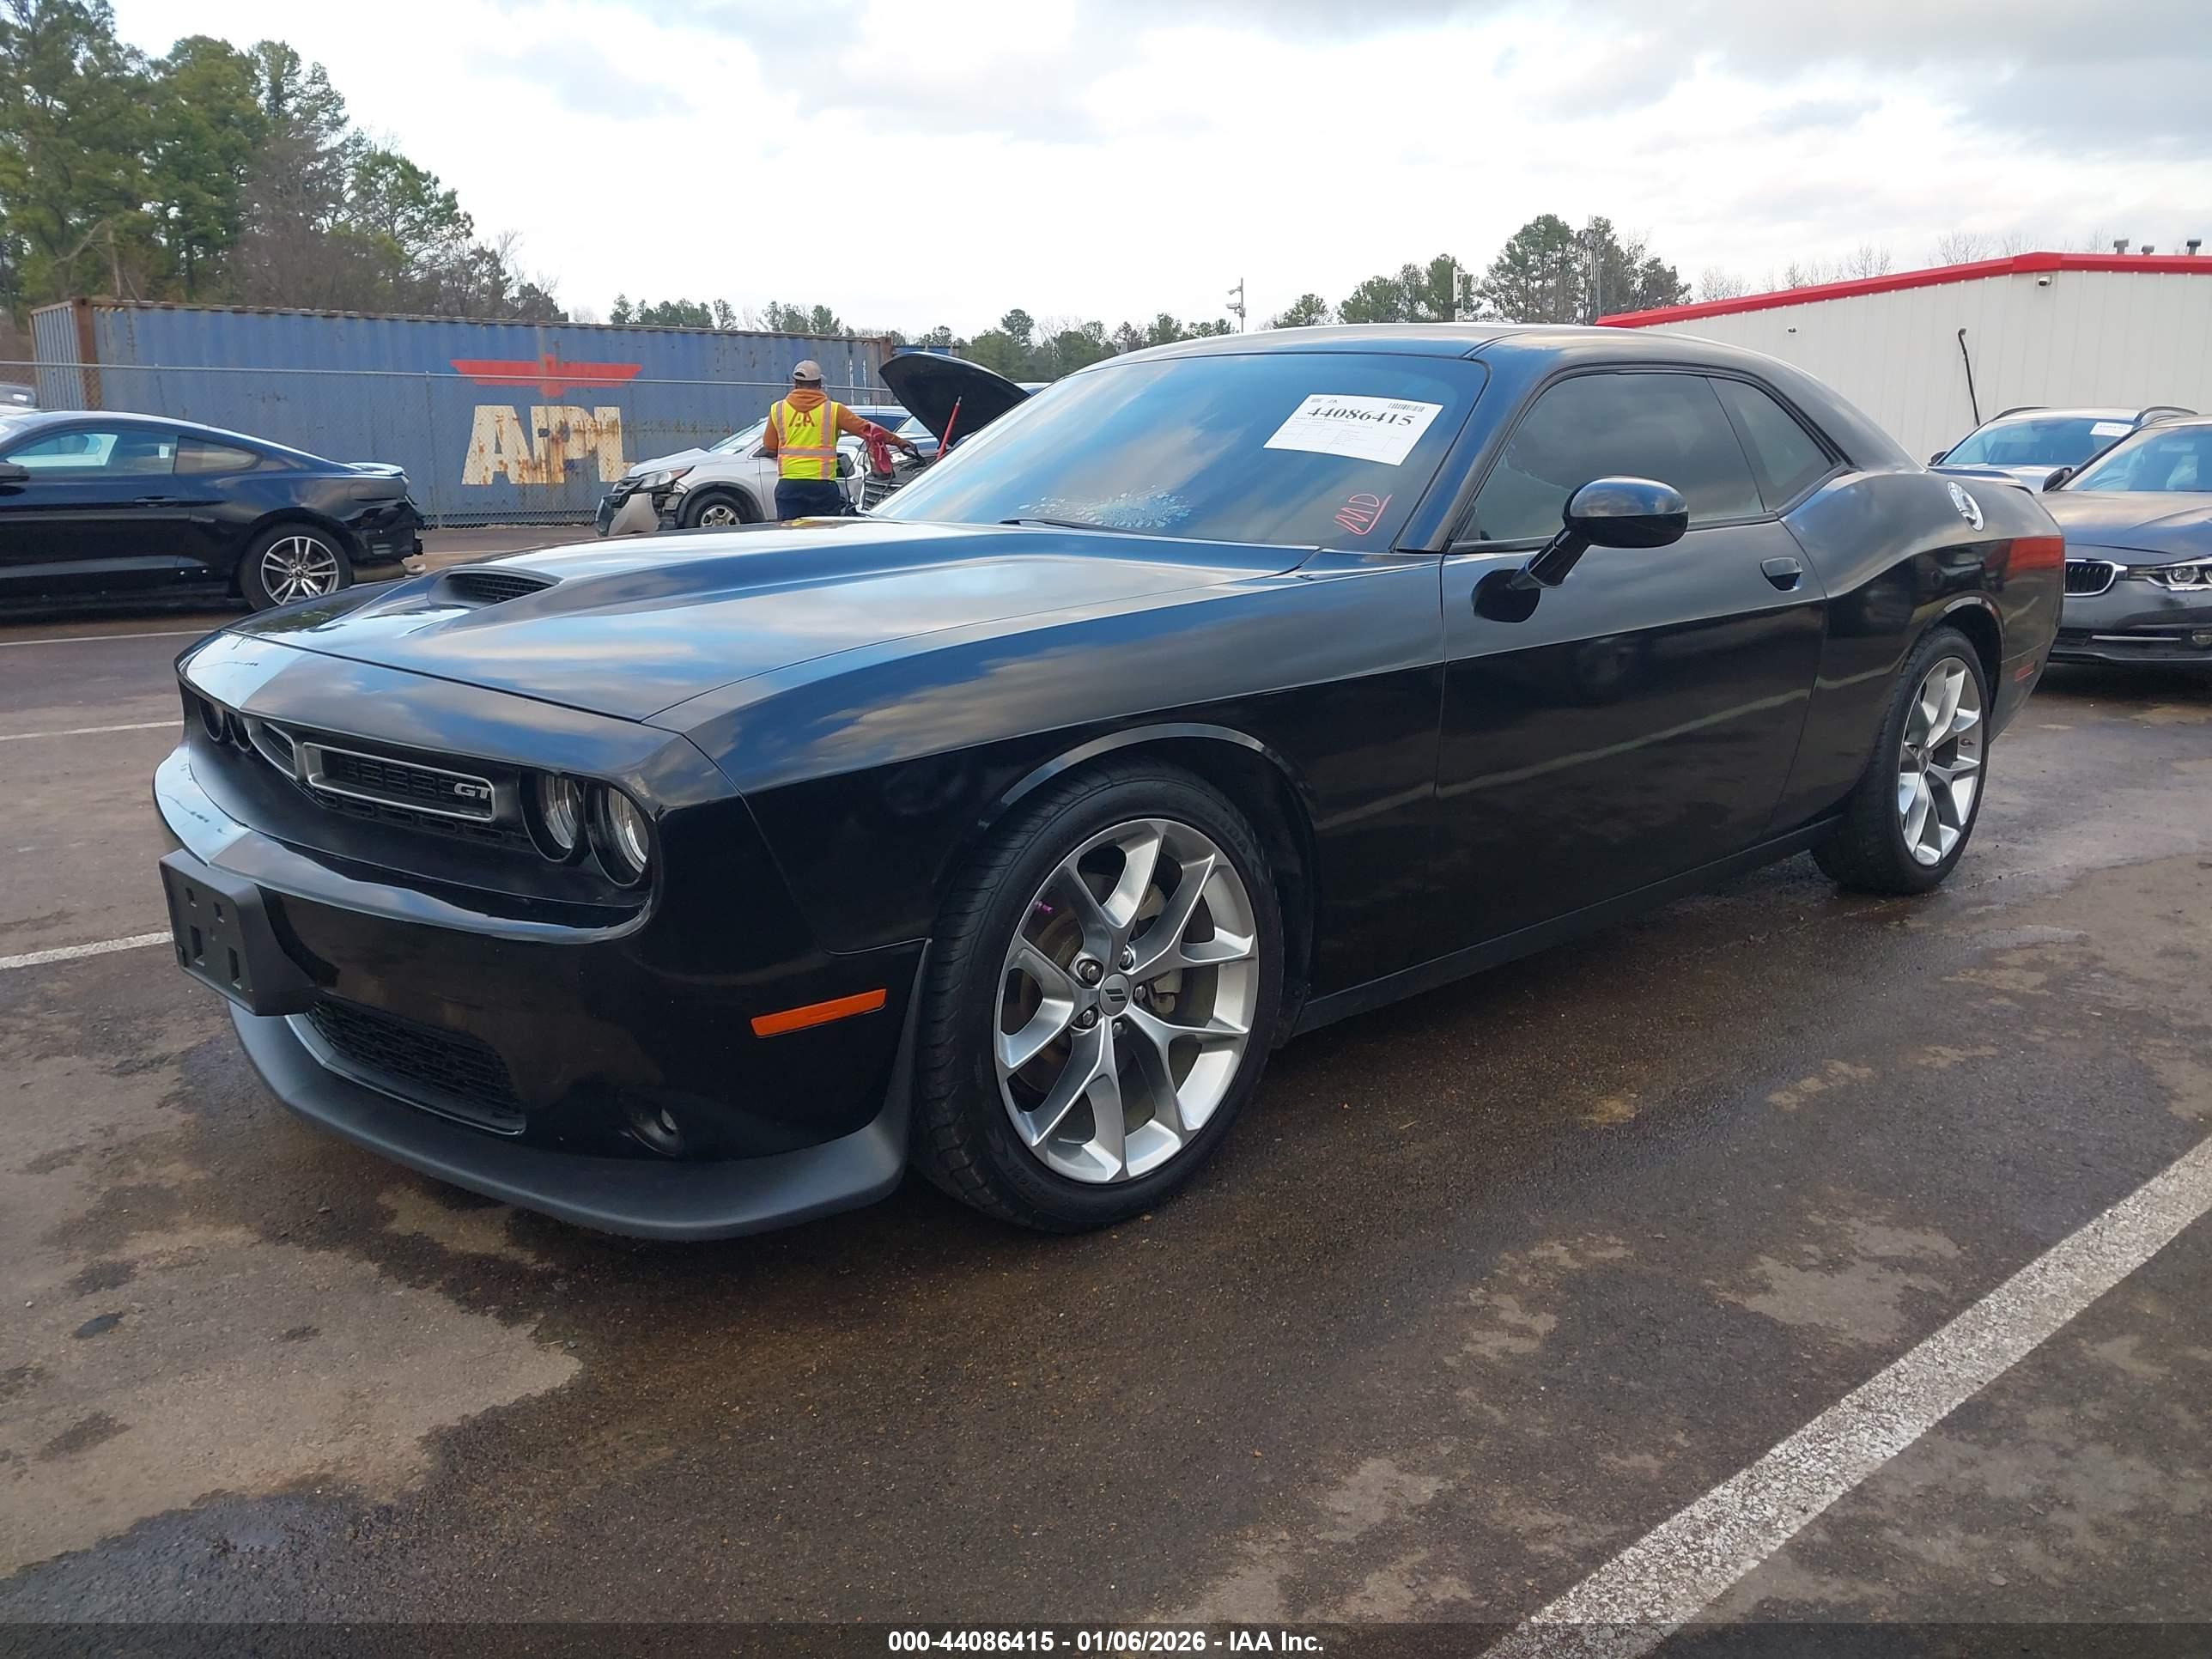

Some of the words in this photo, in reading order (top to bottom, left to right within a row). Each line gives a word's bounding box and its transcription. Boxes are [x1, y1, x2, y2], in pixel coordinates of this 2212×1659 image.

[1307, 406, 1415, 426] 44086415
[461, 405, 636, 485] APL
[454, 782, 490, 799] GT
